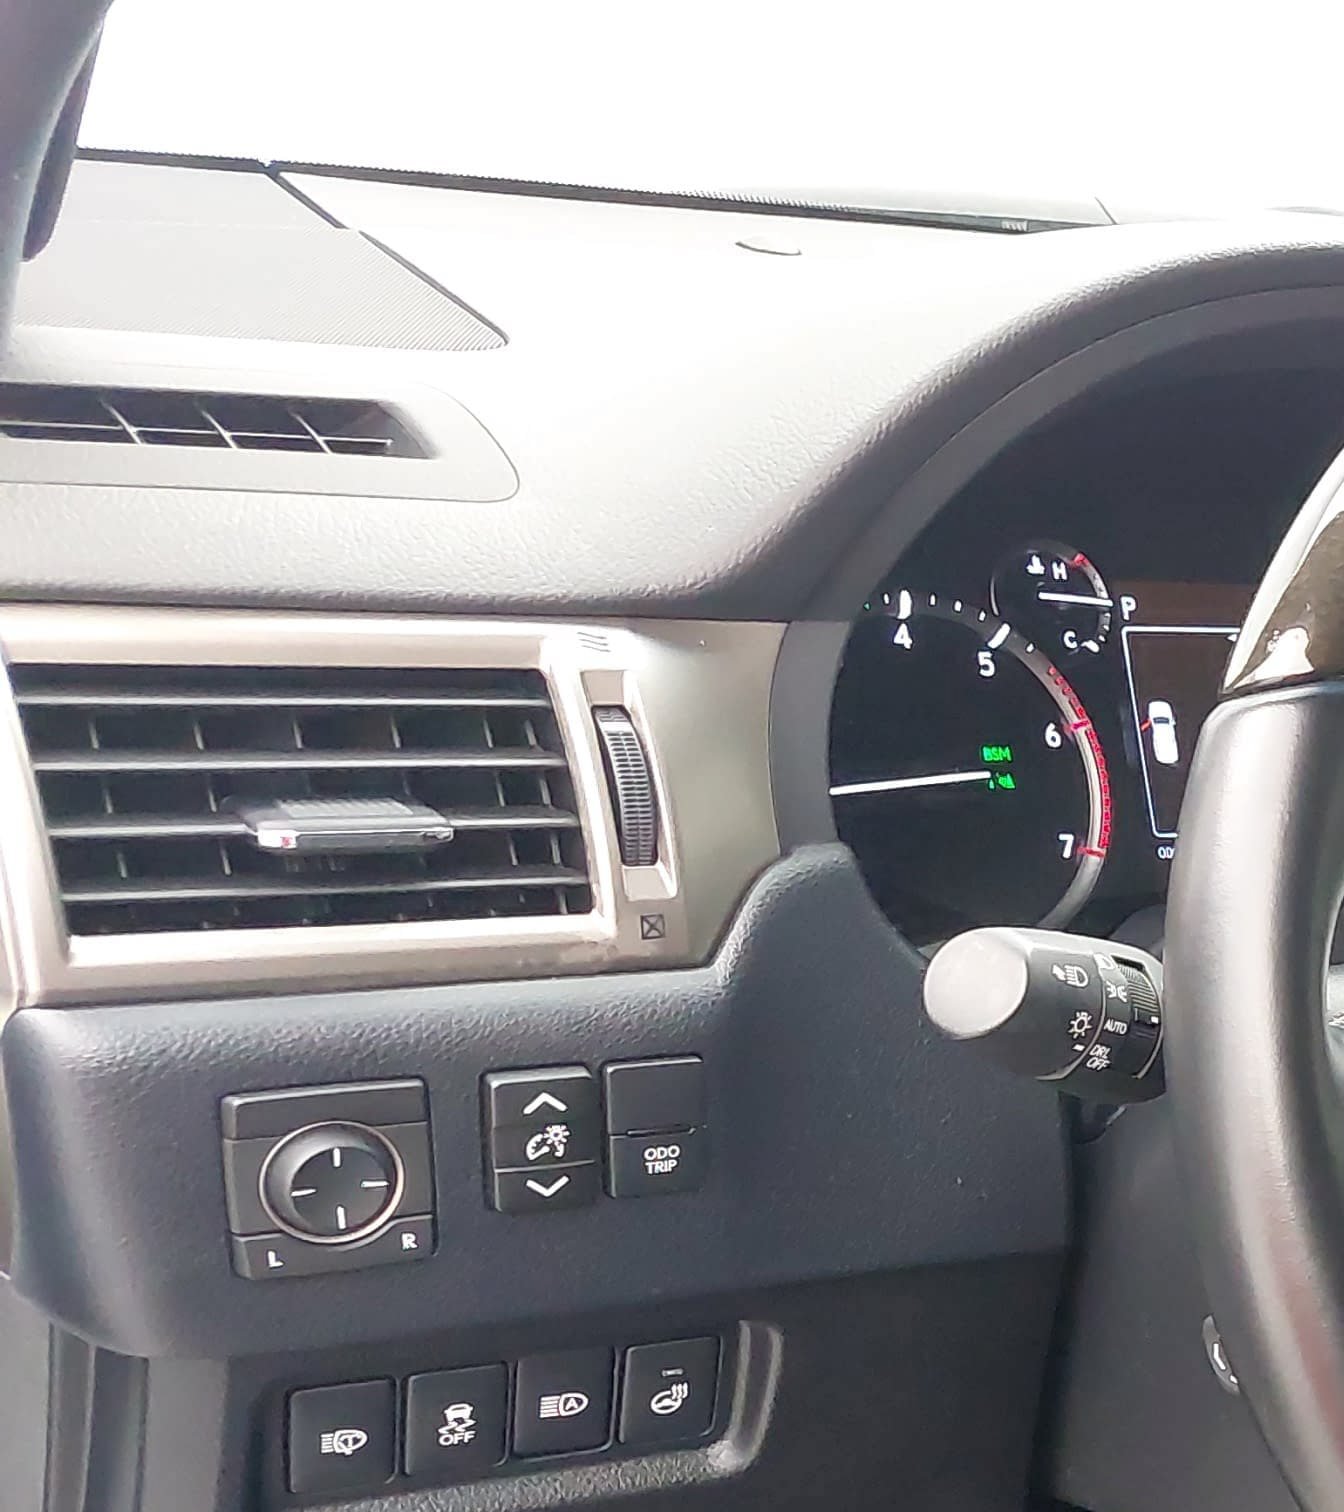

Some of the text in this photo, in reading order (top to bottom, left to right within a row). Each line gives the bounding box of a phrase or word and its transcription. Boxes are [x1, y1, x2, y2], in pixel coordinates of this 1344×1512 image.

[1052, 561, 1068, 581] H
[1120, 596, 1136, 620] P
[893, 623, 913, 649] 4
[1063, 630, 1078, 649] C
[977, 650, 997, 677] 5
[1044, 722, 1062, 748] 6
[982, 746, 1013, 762] BSM
[1058, 833, 1074, 859] 7
[1104, 1018, 1129, 1035] AUTO
[1089, 1044, 1110, 1060] DRL
[1086, 1056, 1111, 1071] OFF
[644, 1145, 681, 1161] ODO
[645, 1159, 678, 1175] TRIP
[402, 1233, 418, 1250] R
[267, 1250, 283, 1268] L
[438, 1431, 475, 1446] OFF
